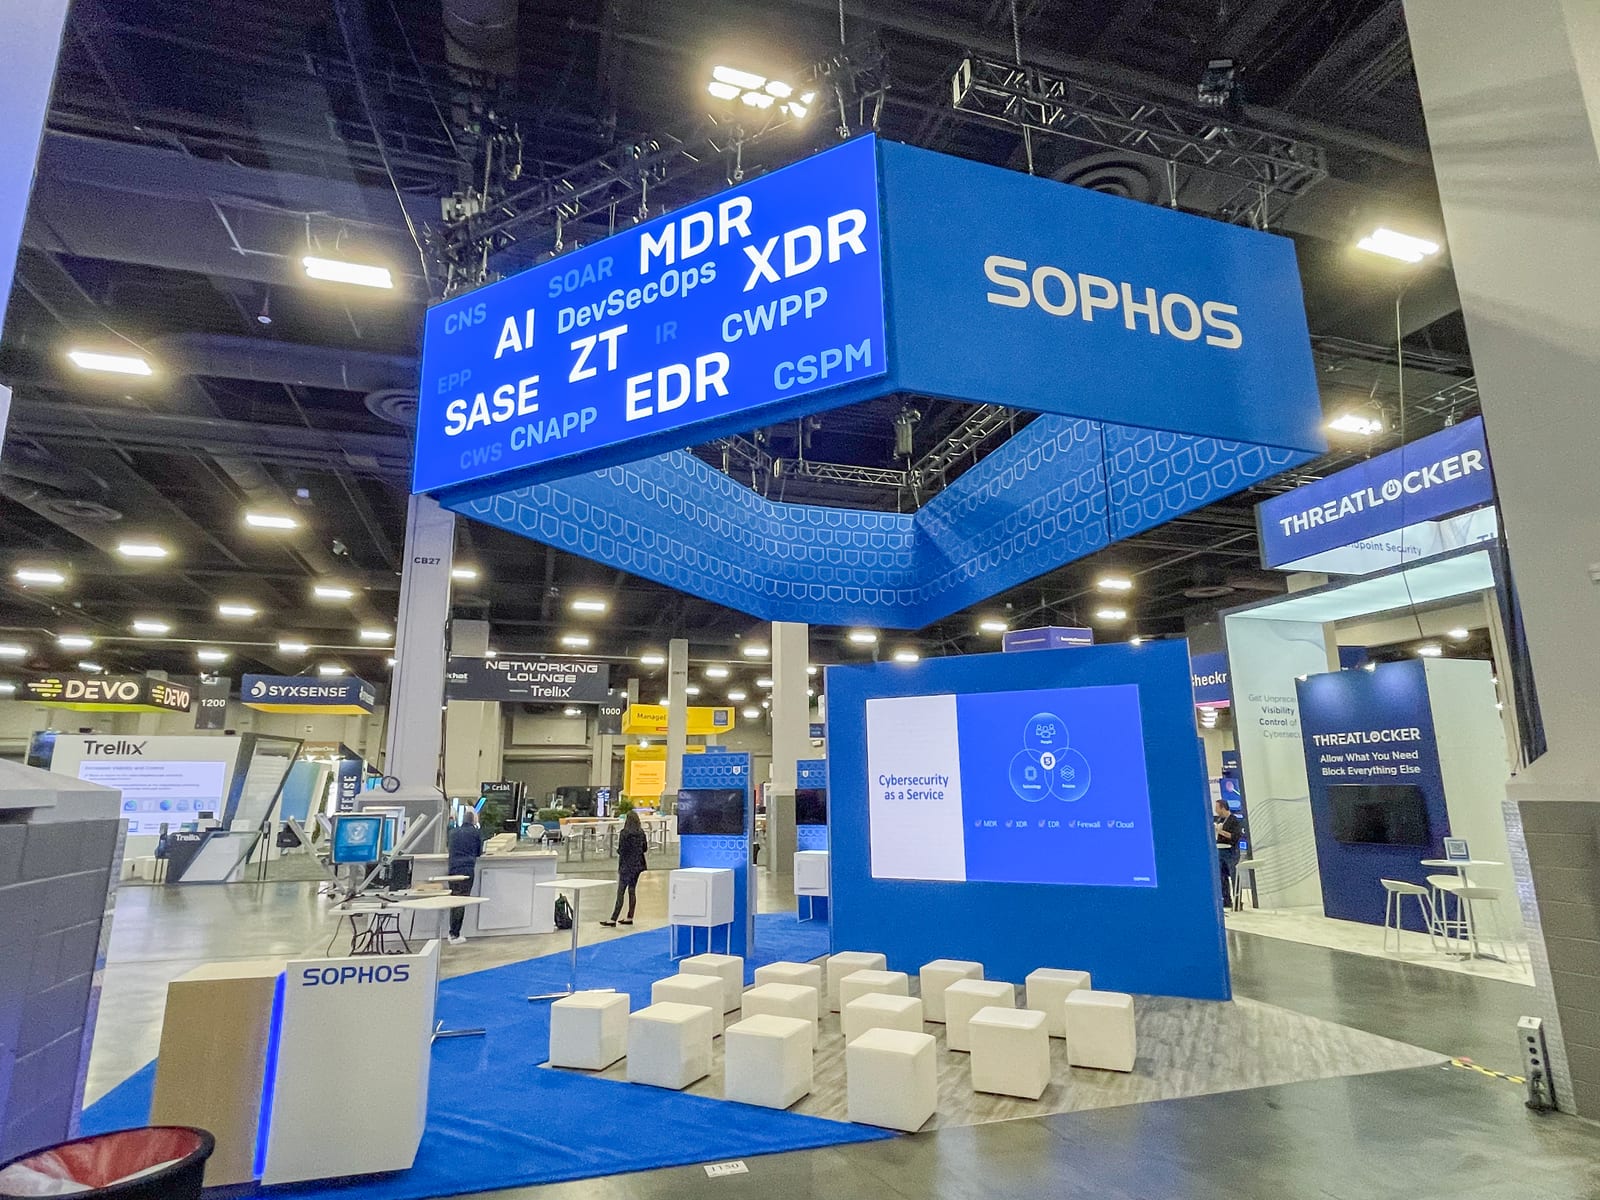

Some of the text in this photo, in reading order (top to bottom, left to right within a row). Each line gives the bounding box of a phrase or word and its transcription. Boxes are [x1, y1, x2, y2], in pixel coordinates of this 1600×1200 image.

[639, 196, 753, 275] MDR
[742, 208, 868, 292] XDR
[548, 256, 614, 298] SOAR
[557, 261, 716, 335] DevSecOps
[983, 255, 1243, 349] SOPHOS
[444, 303, 487, 335] CNS
[721, 287, 828, 343] CWPP
[494, 309, 536, 359] AI
[655, 321, 678, 344] IR
[568, 325, 628, 383] ZT
[773, 339, 872, 390] CSPM
[437, 369, 472, 394] EPP
[625, 352, 731, 422] EDR
[444, 376, 540, 436] SASE
[510, 407, 598, 452] CNAPP
[459, 443, 502, 470] CWS
[1279, 449, 1485, 537] THREATLOCKER
[1386, 543, 1422, 556] Security
[414, 556, 441, 565] CB27
[485, 661, 598, 673] NETWORKING
[507, 672, 577, 683] LOUNGE
[65, 680, 139, 700] DEVO
[163, 688, 190, 708] DEVO
[268, 686, 347, 697] SYXSENSE
[531, 685, 573, 697] Trellix
[201, 699, 226, 707] 1200
[601, 707, 621, 715] 1000
[1261, 706, 1296, 716] Visibility
[1259, 718, 1288, 726] Control
[83, 740, 148, 755] Trellix
[1312, 727, 1422, 747] THREATLOCKER
[1320, 750, 1419, 763] Allow What You Need
[879, 773, 949, 788] Cybersecurity
[1322, 764, 1421, 776] Block Everything Else
[884, 788, 944, 800] as a Service
[302, 964, 410, 986] SOPHOS
